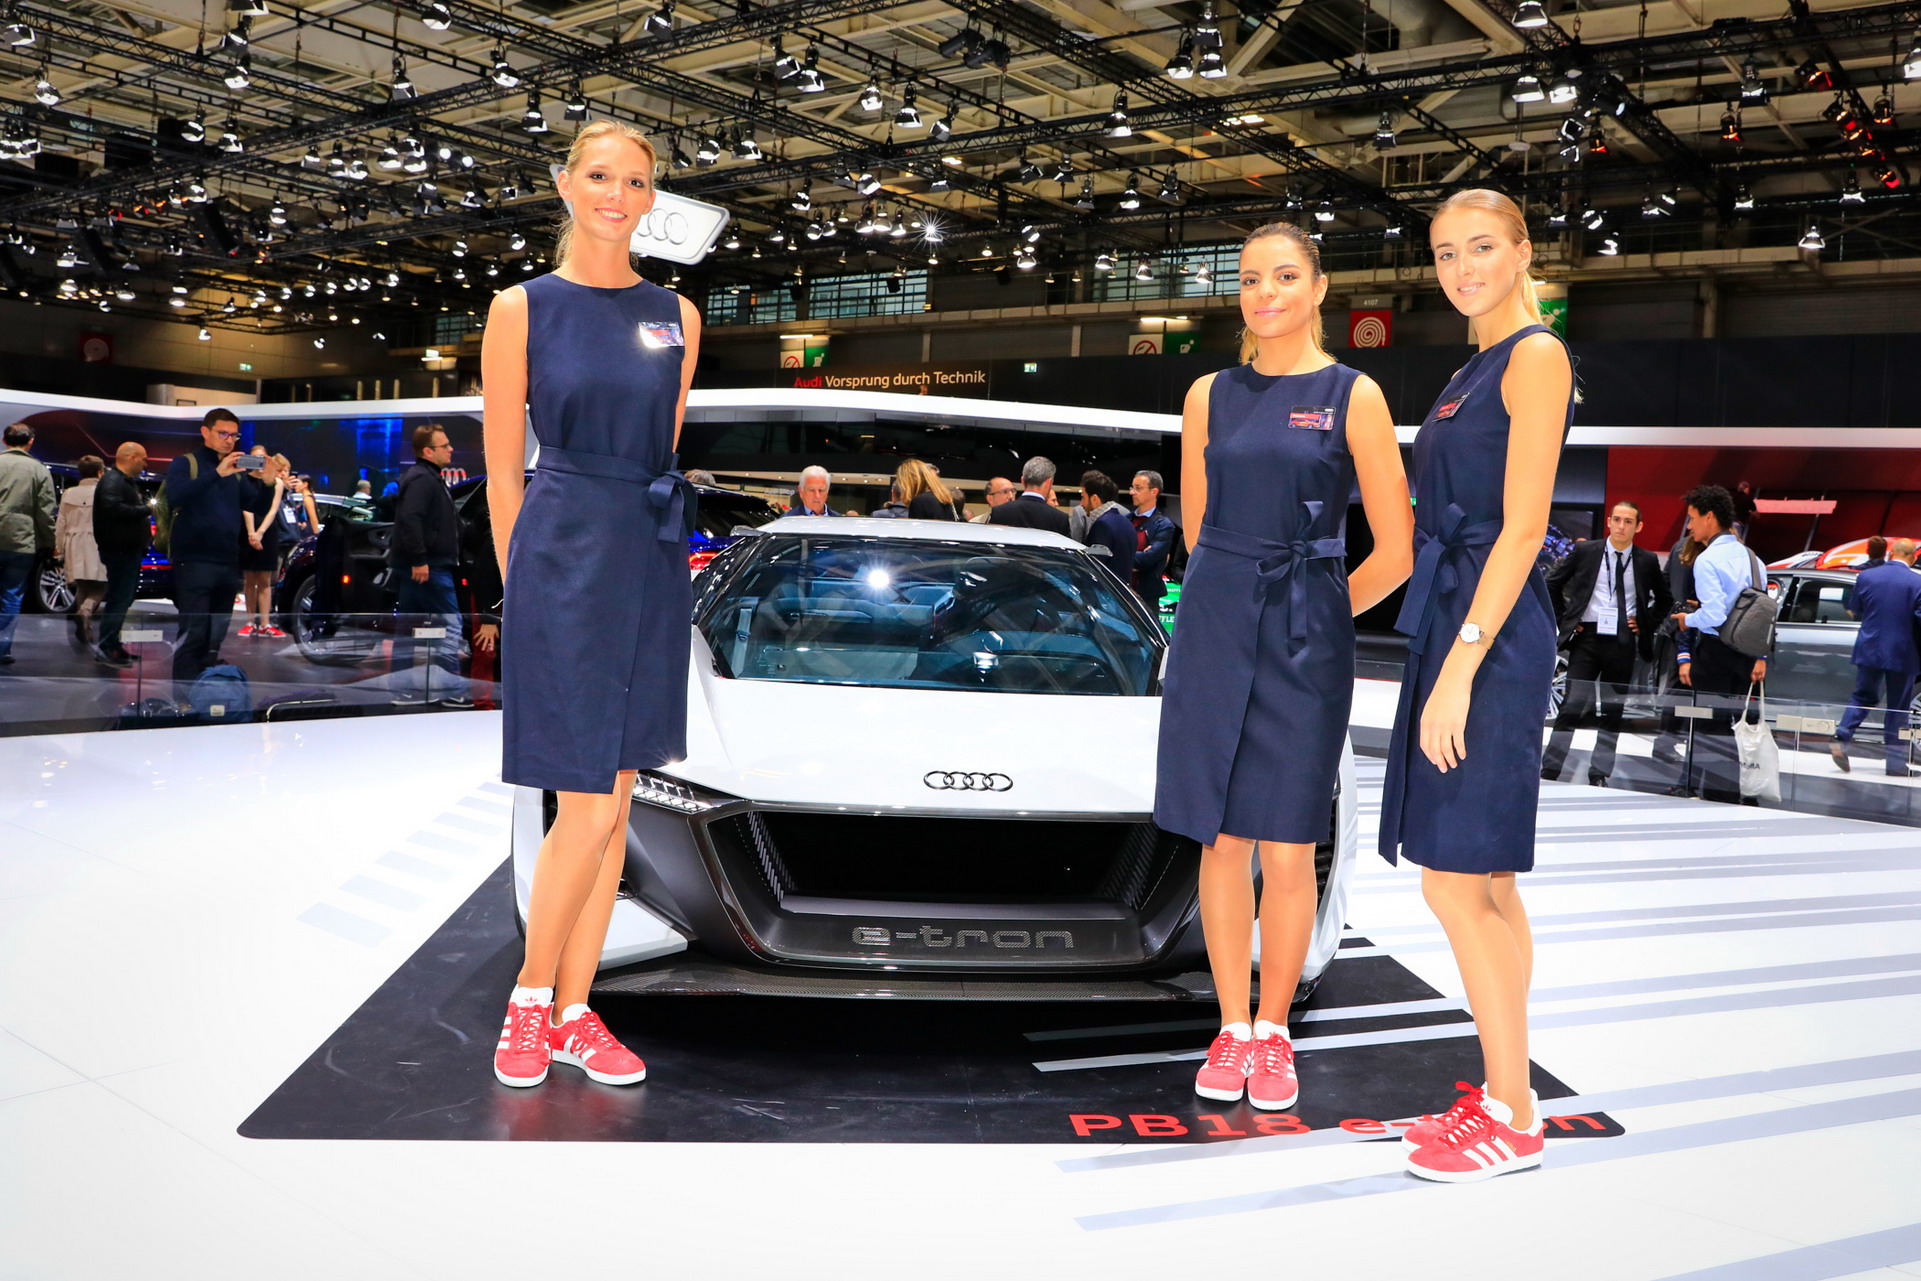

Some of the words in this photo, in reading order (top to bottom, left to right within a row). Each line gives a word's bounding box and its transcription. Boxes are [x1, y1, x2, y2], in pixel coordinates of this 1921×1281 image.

[793, 376, 823, 388] Audi
[825, 374, 890, 389] Vorsprung
[893, 373, 930, 386] durch
[933, 370, 986, 385] Technik
[852, 925, 1074, 948] e-tron
[1068, 1113, 1312, 1137] PB18
